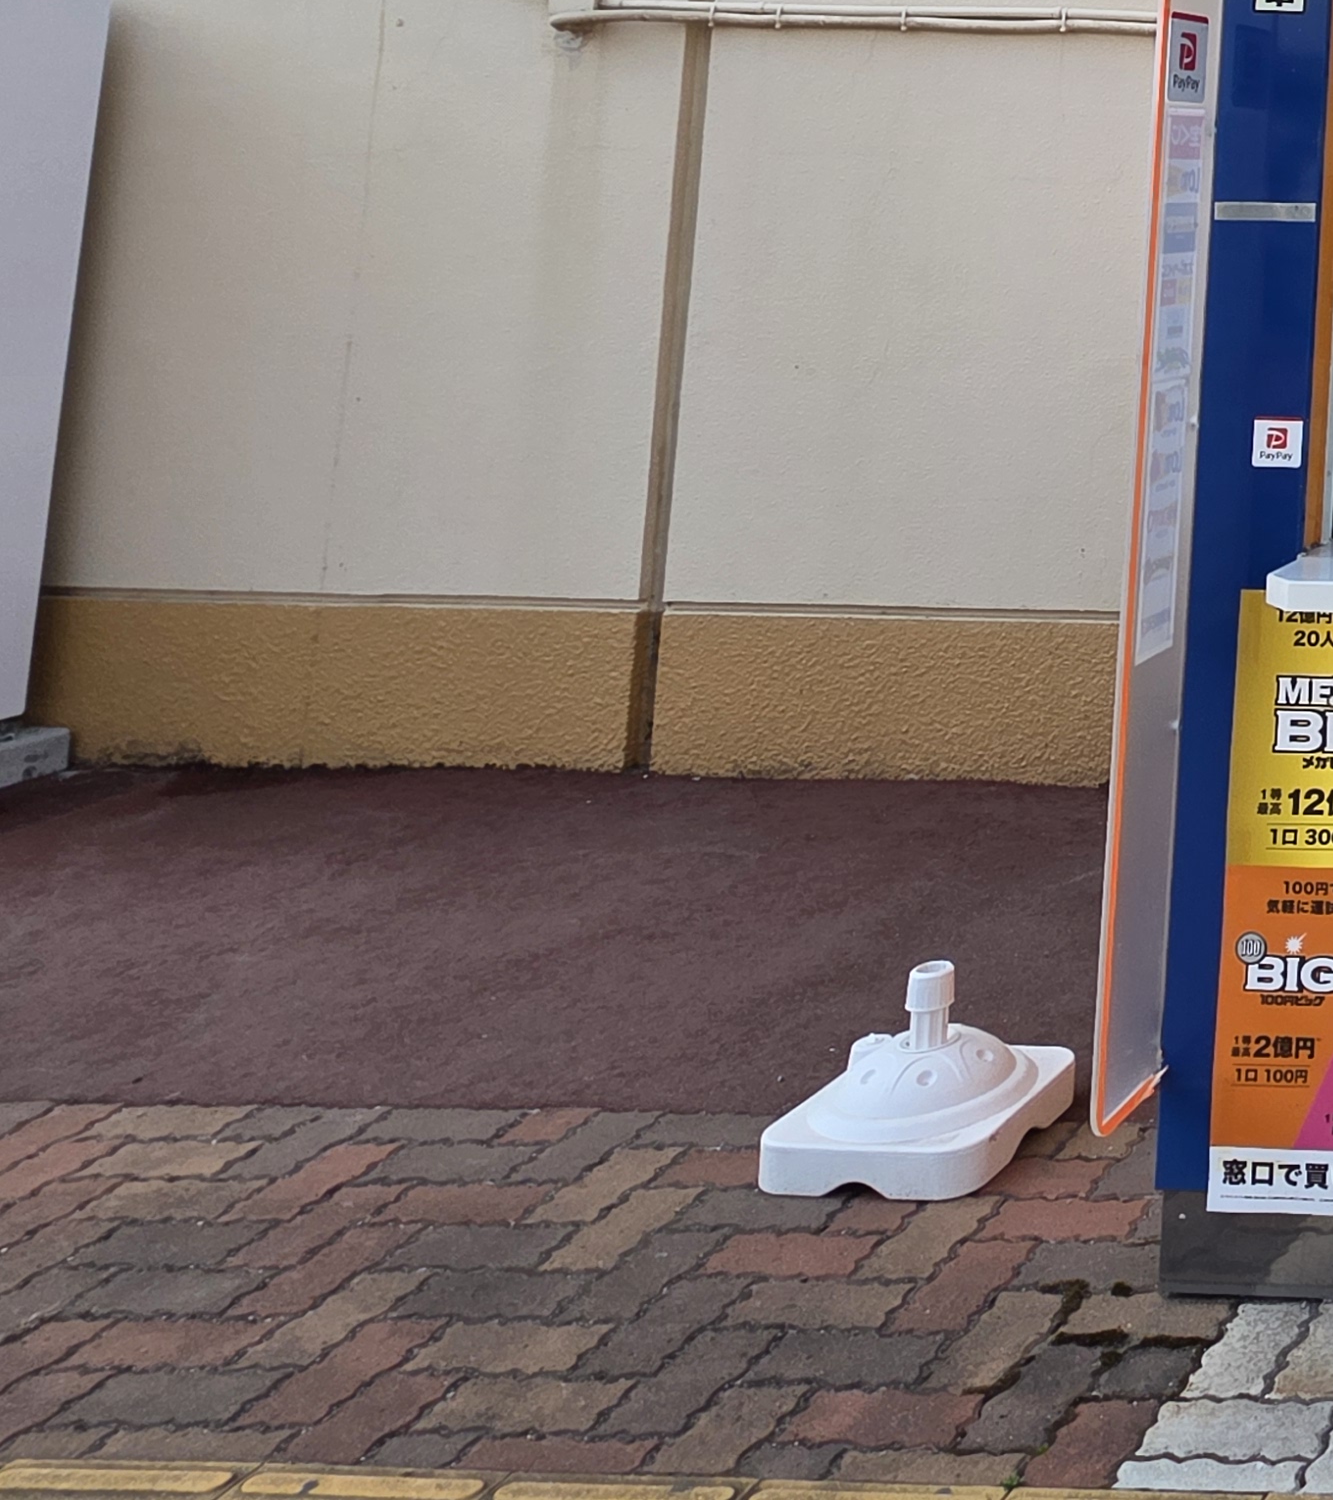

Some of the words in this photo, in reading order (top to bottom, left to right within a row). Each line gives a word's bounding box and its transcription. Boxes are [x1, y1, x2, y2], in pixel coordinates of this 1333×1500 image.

[1172, 73, 1200, 92] PayPay
[1259, 450, 1293, 462] PayPay
[1269, 830, 1299, 846] 1口
[1239, 938, 1263, 958] 100
[1260, 994, 1326, 1007] 100円ビッグ
[1254, 1035, 1316, 1060] 2億円
[1234, 1068, 1258, 1083] 1口
[1264, 1068, 1308, 1084] 100円
